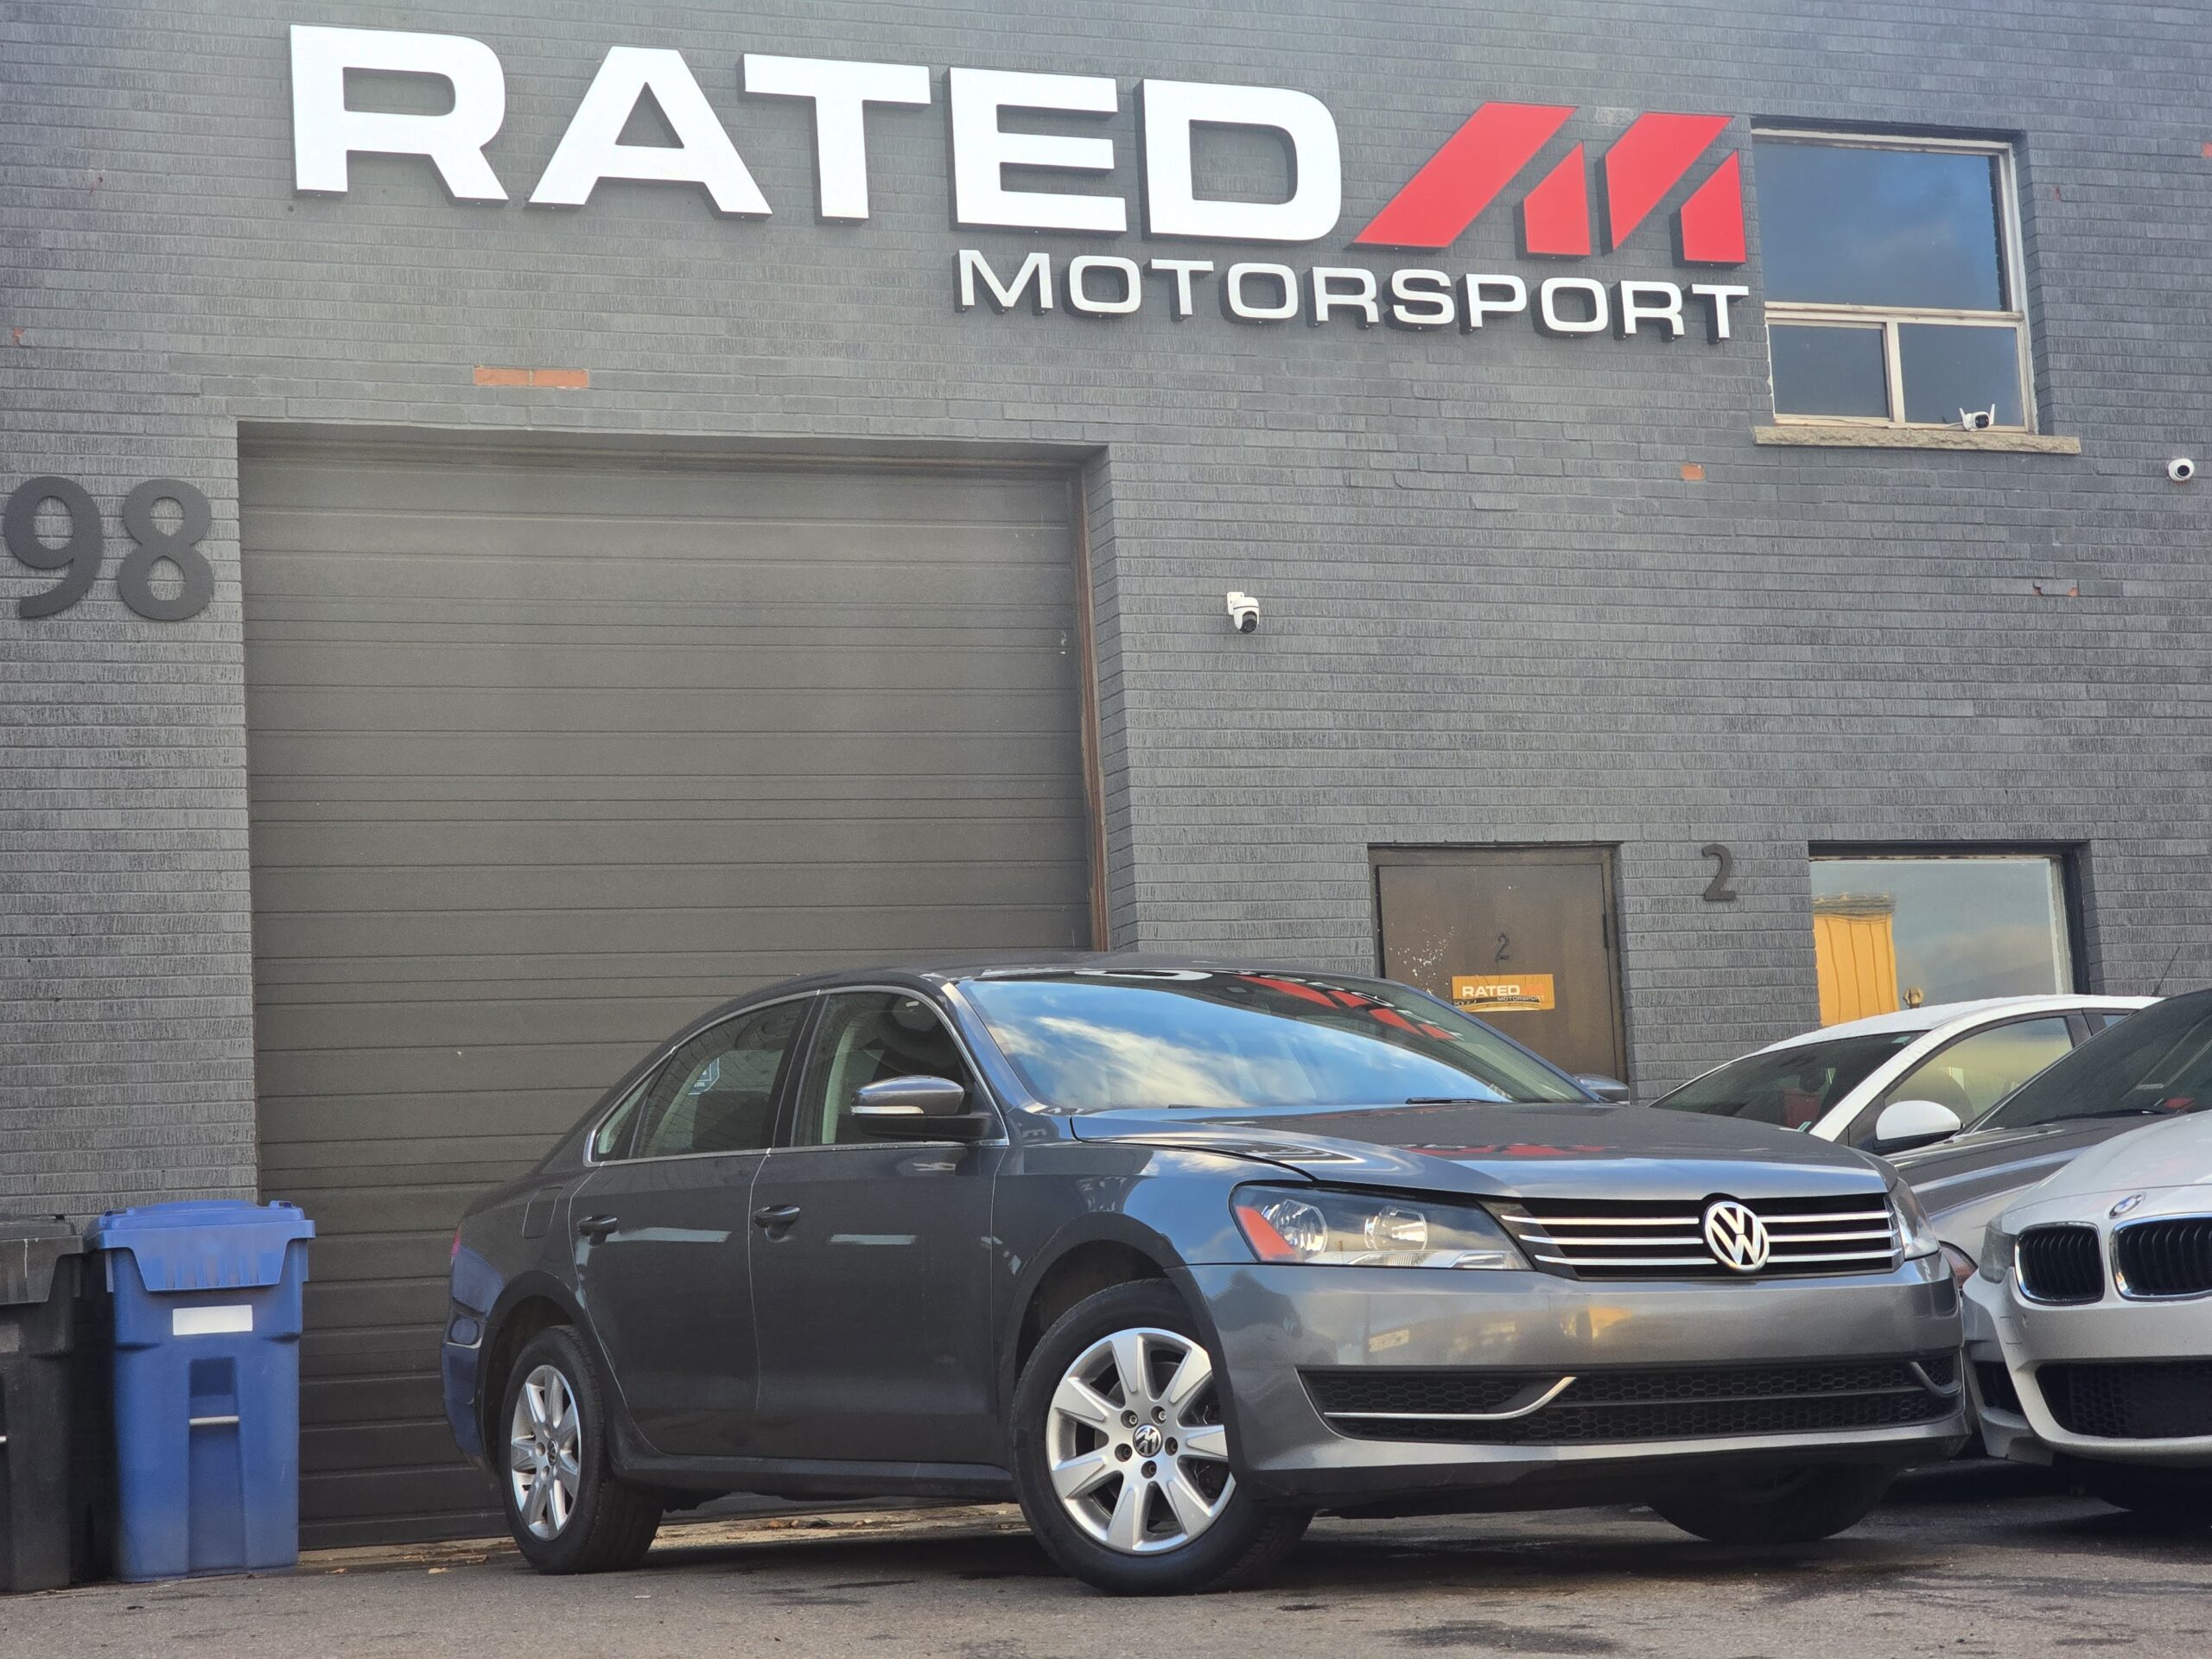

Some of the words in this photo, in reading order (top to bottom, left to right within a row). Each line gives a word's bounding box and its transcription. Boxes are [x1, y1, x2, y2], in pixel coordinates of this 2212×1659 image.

[289, 24, 1343, 243] RATED
[957, 248, 1750, 342] MOTORSPORT
[3, 475, 214, 621] 98
[1700, 843, 1737, 901] 2
[1494, 932, 1510, 963] 2
[1461, 984, 1521, 997] RATED
